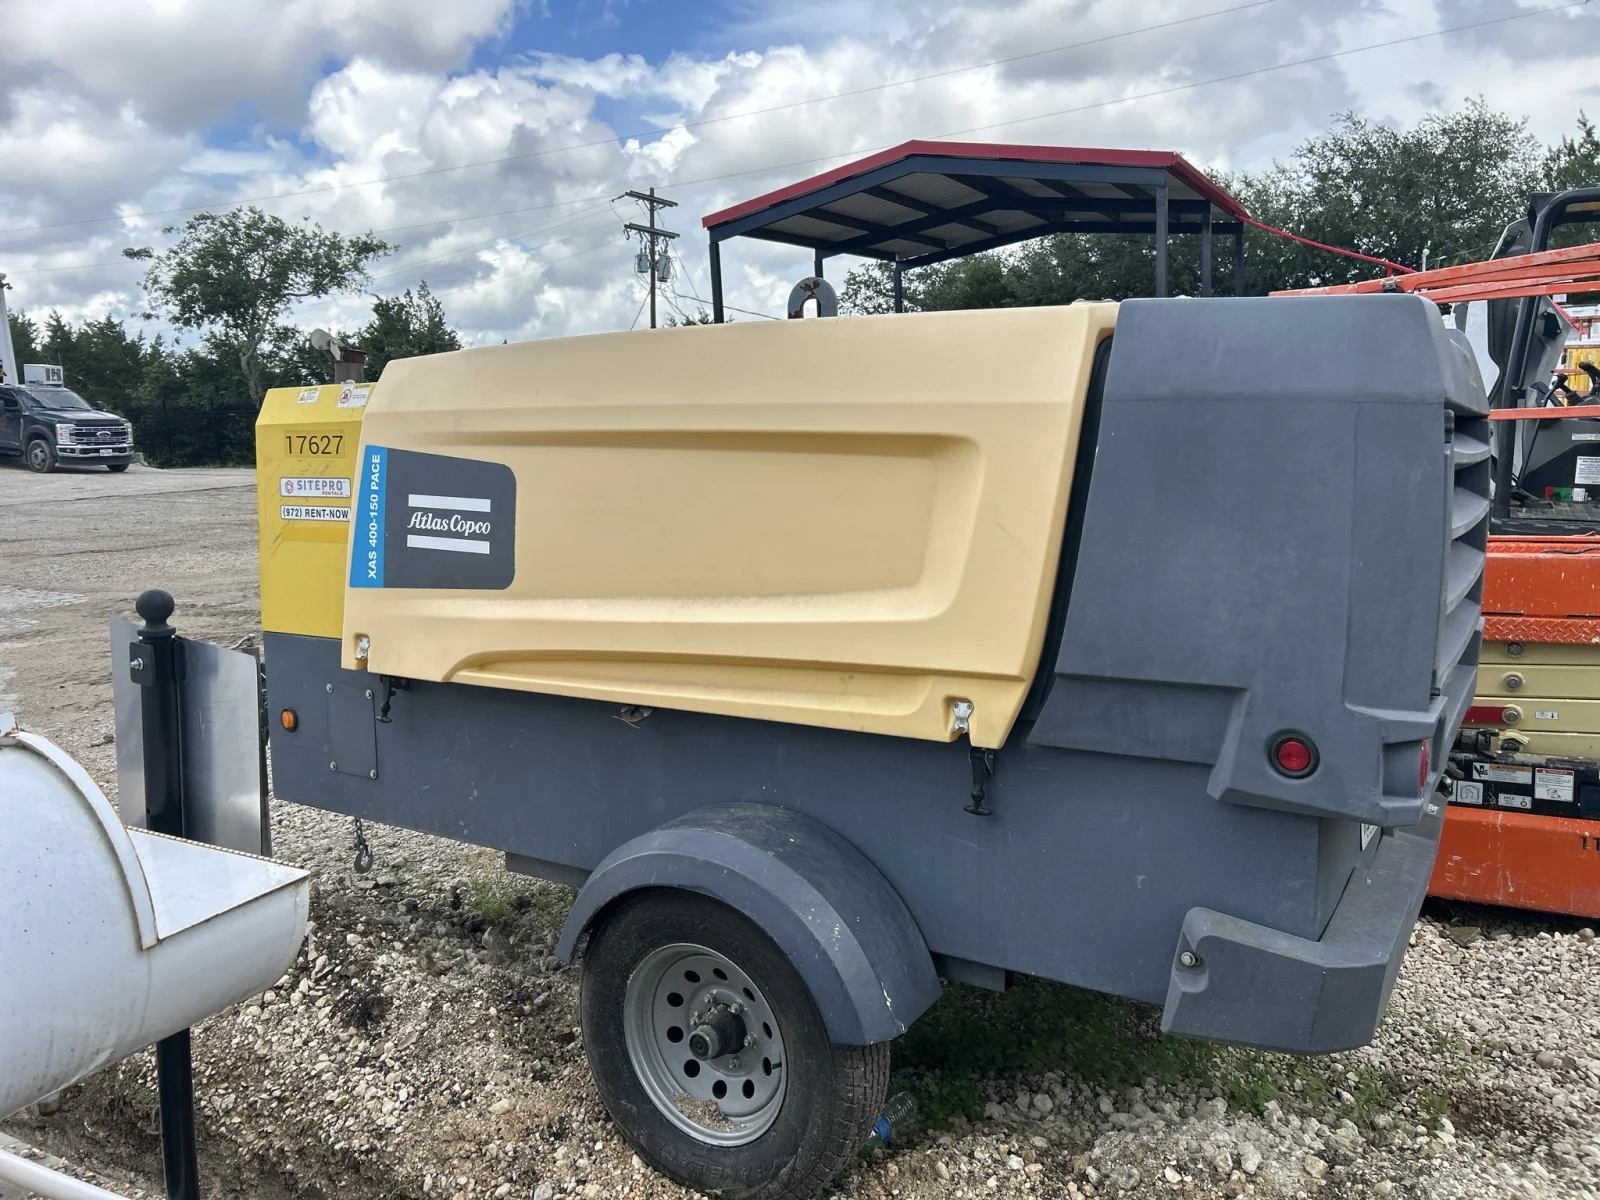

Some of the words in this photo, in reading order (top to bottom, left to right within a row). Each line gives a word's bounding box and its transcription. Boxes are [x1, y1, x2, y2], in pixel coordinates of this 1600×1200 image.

[285, 435, 344, 455] 17627
[296, 480, 343, 491] SITEPRO
[370, 454, 381, 491] PACE
[282, 506, 303, 518] (972)
[304, 508, 349, 519] RENT-NOW
[368, 493, 379, 548] 400-150
[406, 511, 449, 531] Atlas
[449, 514, 491, 537] Copco
[367, 550, 378, 579] XAS
